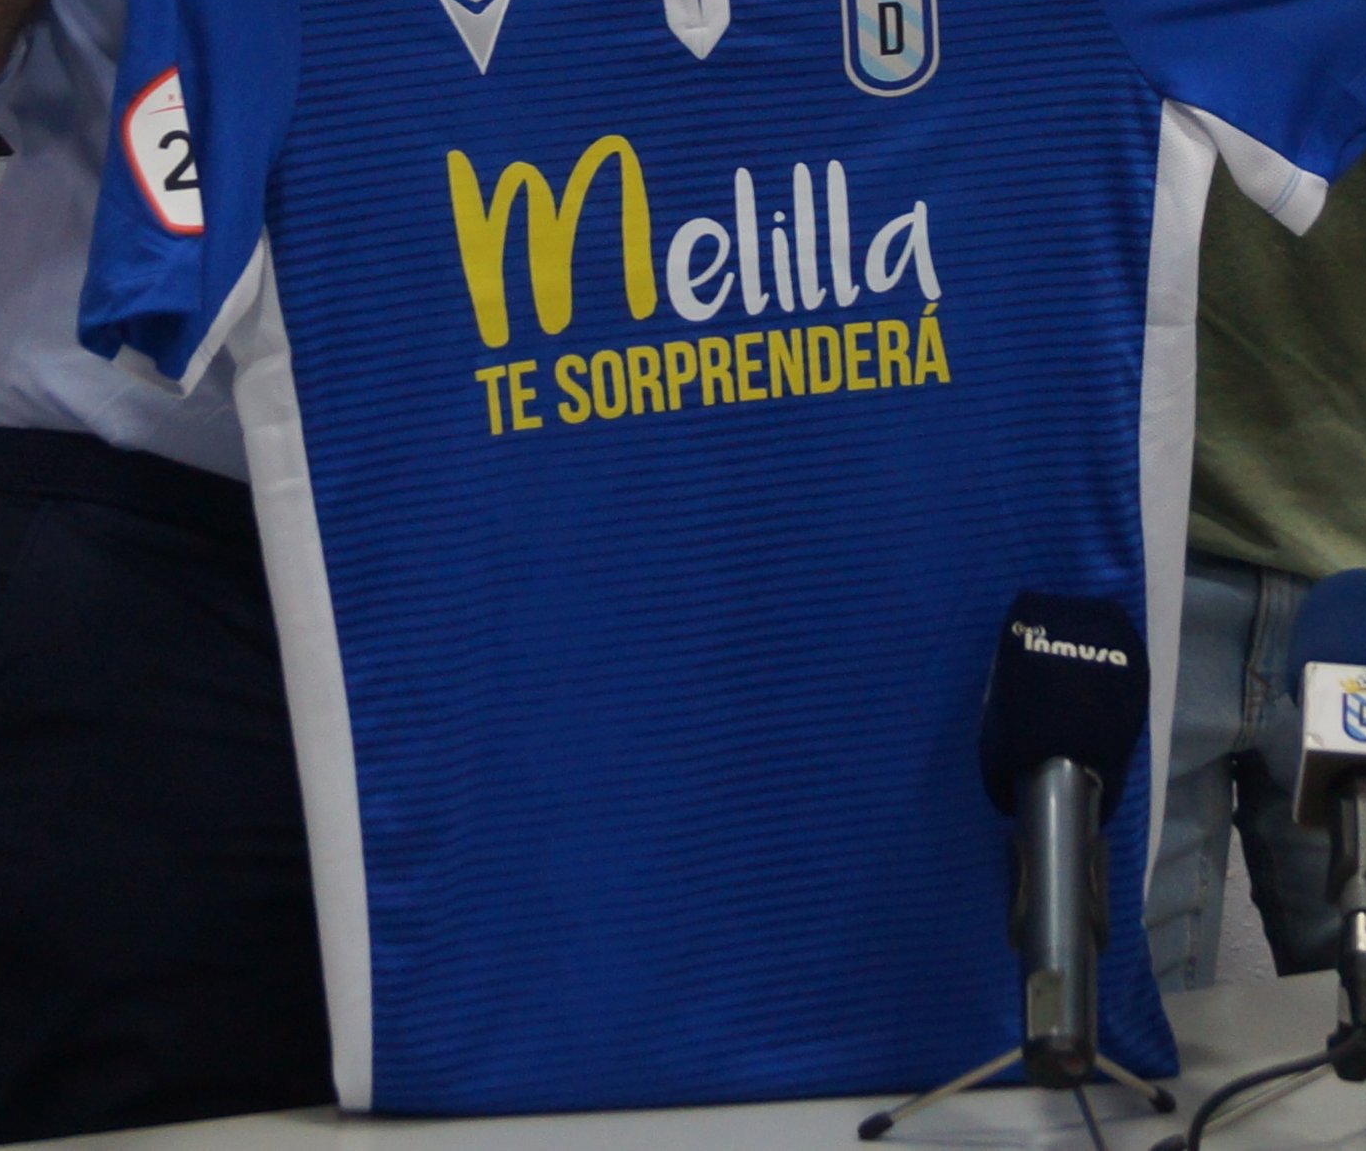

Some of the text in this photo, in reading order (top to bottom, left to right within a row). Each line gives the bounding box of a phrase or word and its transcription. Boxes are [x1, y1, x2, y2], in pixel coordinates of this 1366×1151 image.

[878, 2, 904, 56] D
[447, 134, 942, 348] Melilla
[475, 303, 950, 436] TE SORPRENDERÁ
